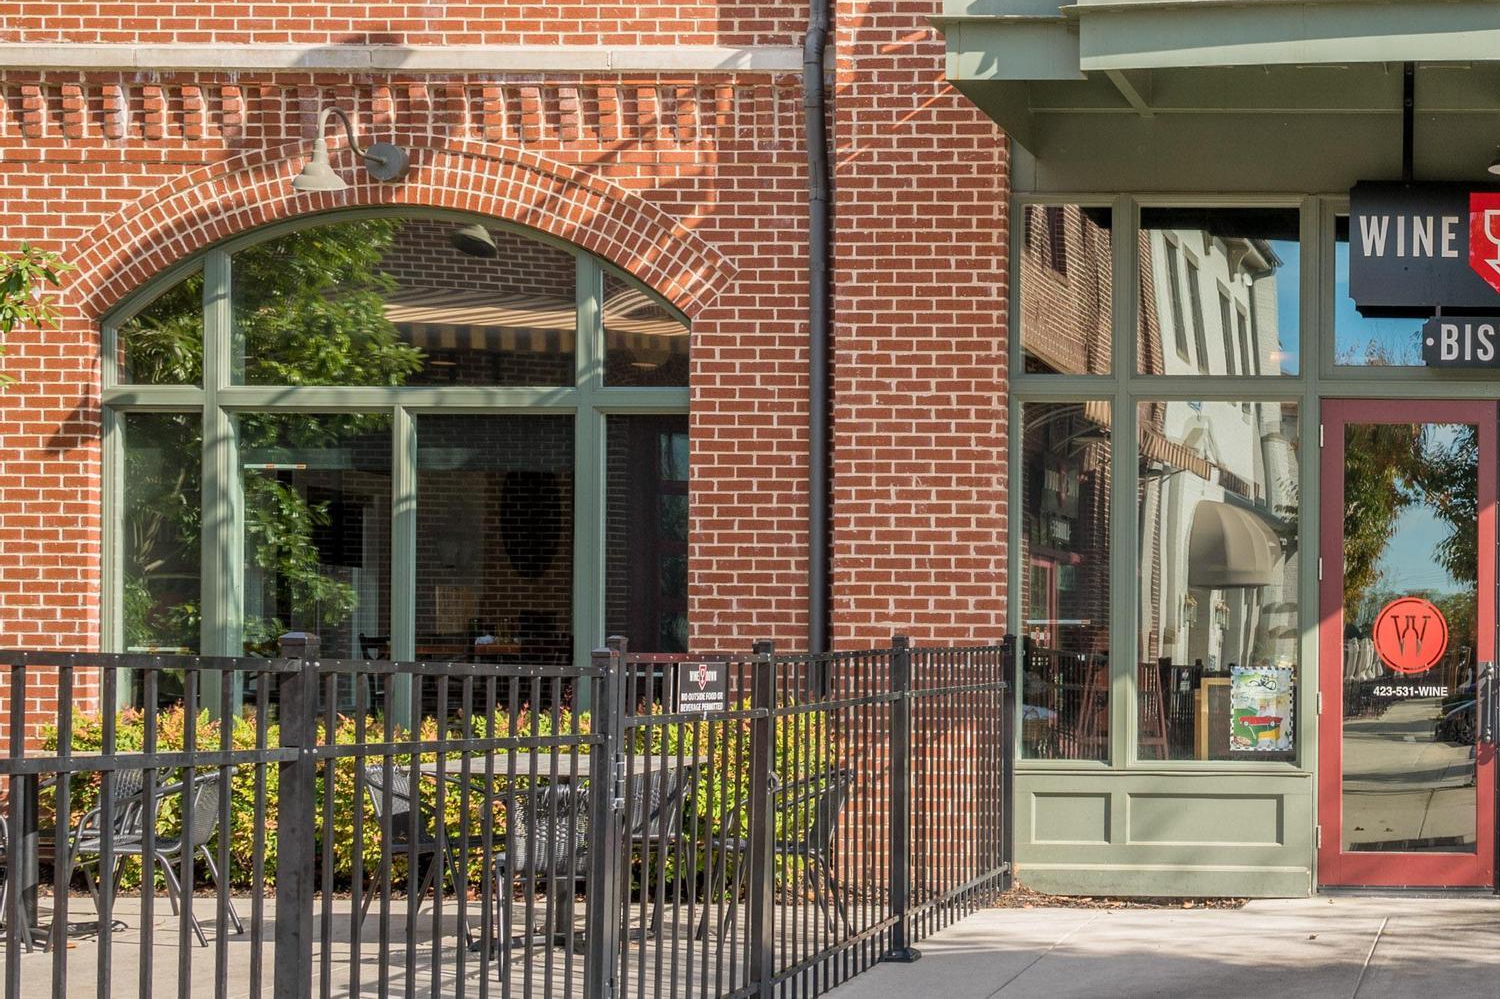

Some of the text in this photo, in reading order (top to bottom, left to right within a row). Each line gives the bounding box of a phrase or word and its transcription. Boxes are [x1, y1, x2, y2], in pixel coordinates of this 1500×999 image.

[1359, 215, 1459, 258] WINE
[688, 692, 705, 701] OUTSIDE
[1372, 686, 1449, 697] 423-531-WINE
